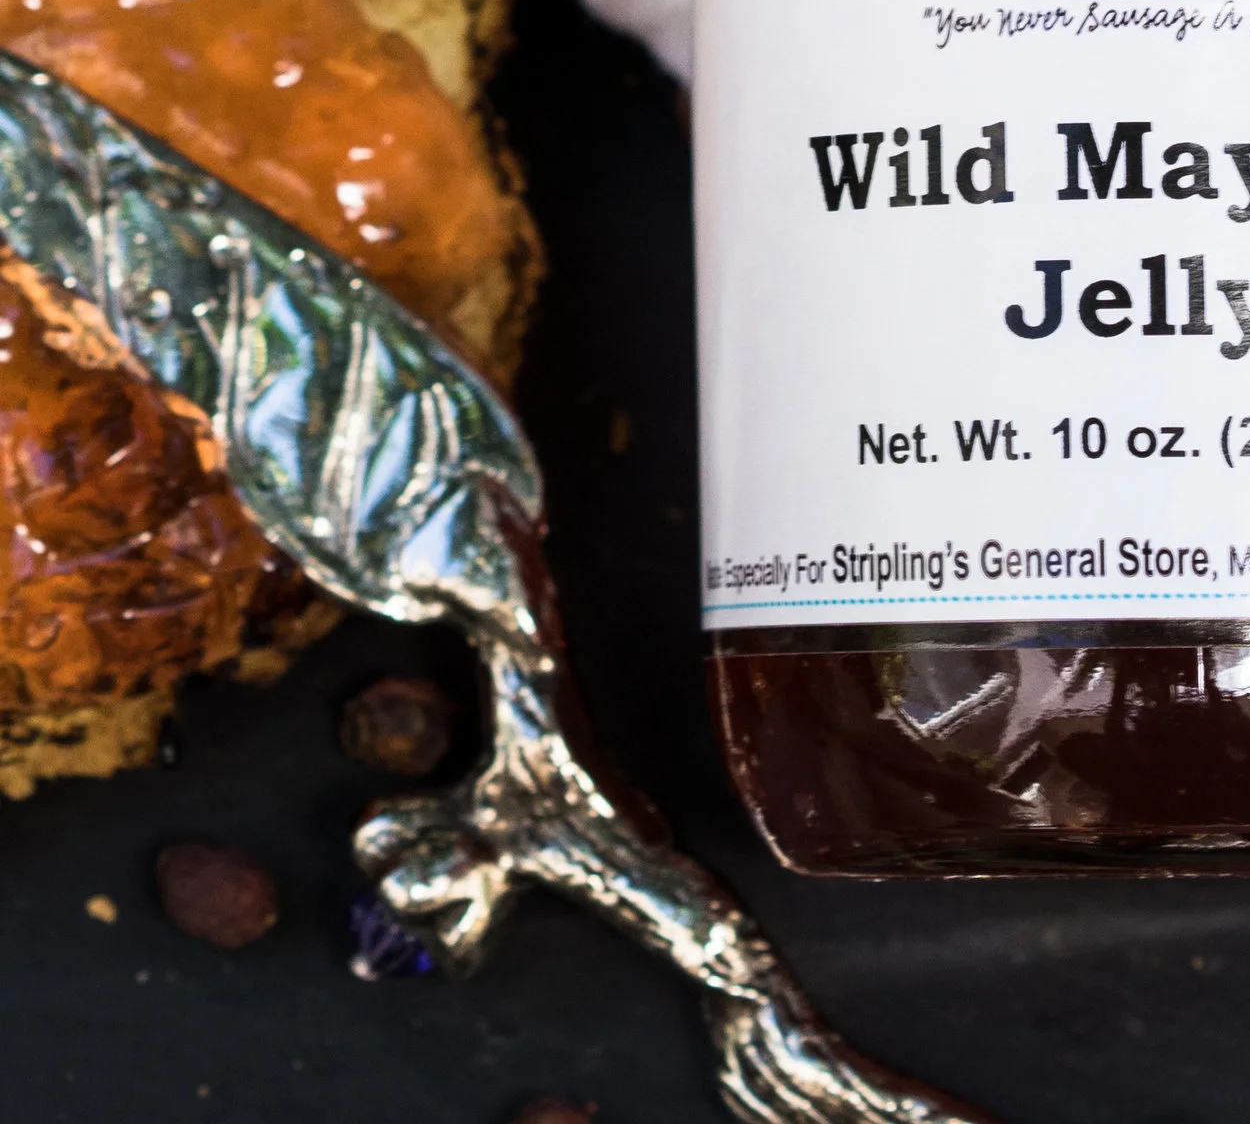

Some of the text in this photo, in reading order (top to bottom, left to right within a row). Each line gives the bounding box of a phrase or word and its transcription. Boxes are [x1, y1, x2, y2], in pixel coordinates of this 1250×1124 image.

[1076, 0, 1203, 42] Sausage
[808, 120, 1016, 213] Wild
[857, 419, 938, 467] Net.
[954, 419, 1032, 462] Wt.
[1051, 417, 1107, 461] 10
[1125, 425, 1201, 460] oz.
[795, 553, 827, 585] For
[832, 540, 970, 593] Stripling's
[980, 538, 1105, 580] General
[1117, 537, 1218, 581] Store,
